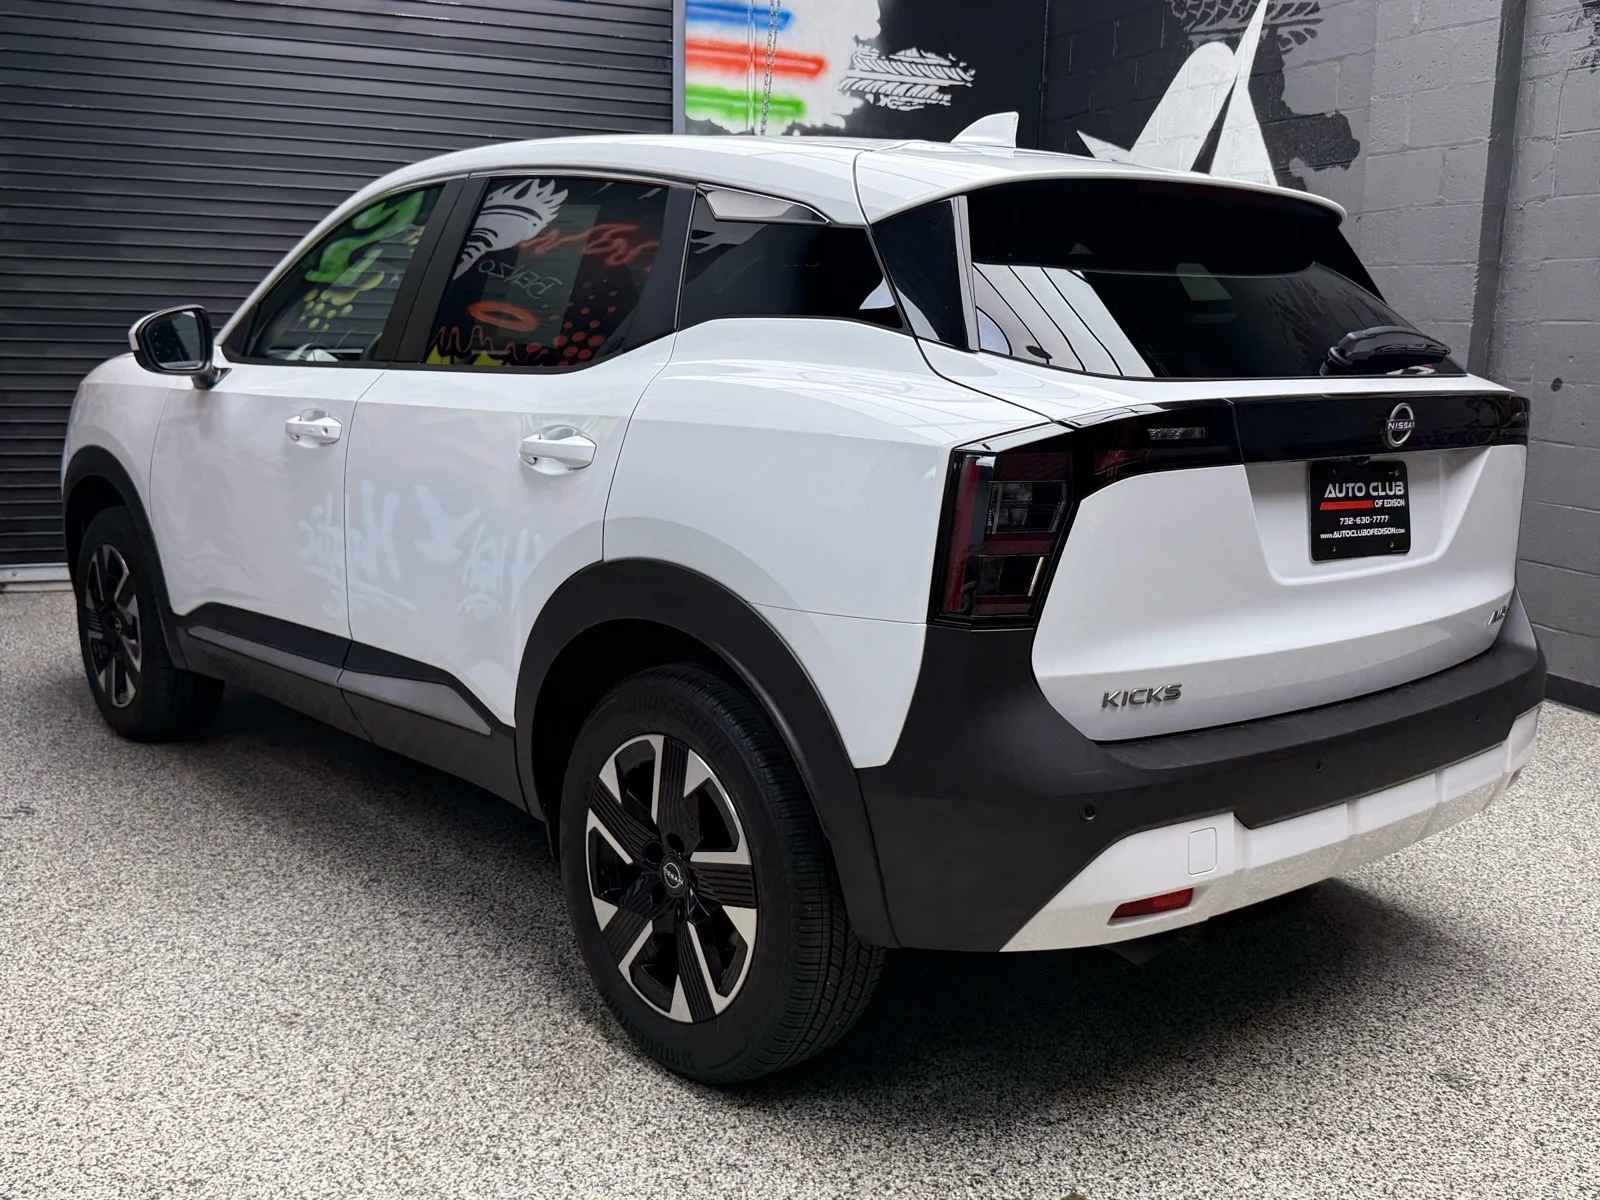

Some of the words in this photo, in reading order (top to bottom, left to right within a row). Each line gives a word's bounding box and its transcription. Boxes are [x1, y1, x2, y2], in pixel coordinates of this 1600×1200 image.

[1387, 421, 1415, 430] NISSAN
[1324, 482, 1366, 498] AUTO
[1369, 481, 1405, 496] CLUB
[1374, 499, 1383, 507] OF
[1384, 498, 1405, 507] EDISON
[1101, 683, 1182, 708] KICKS
